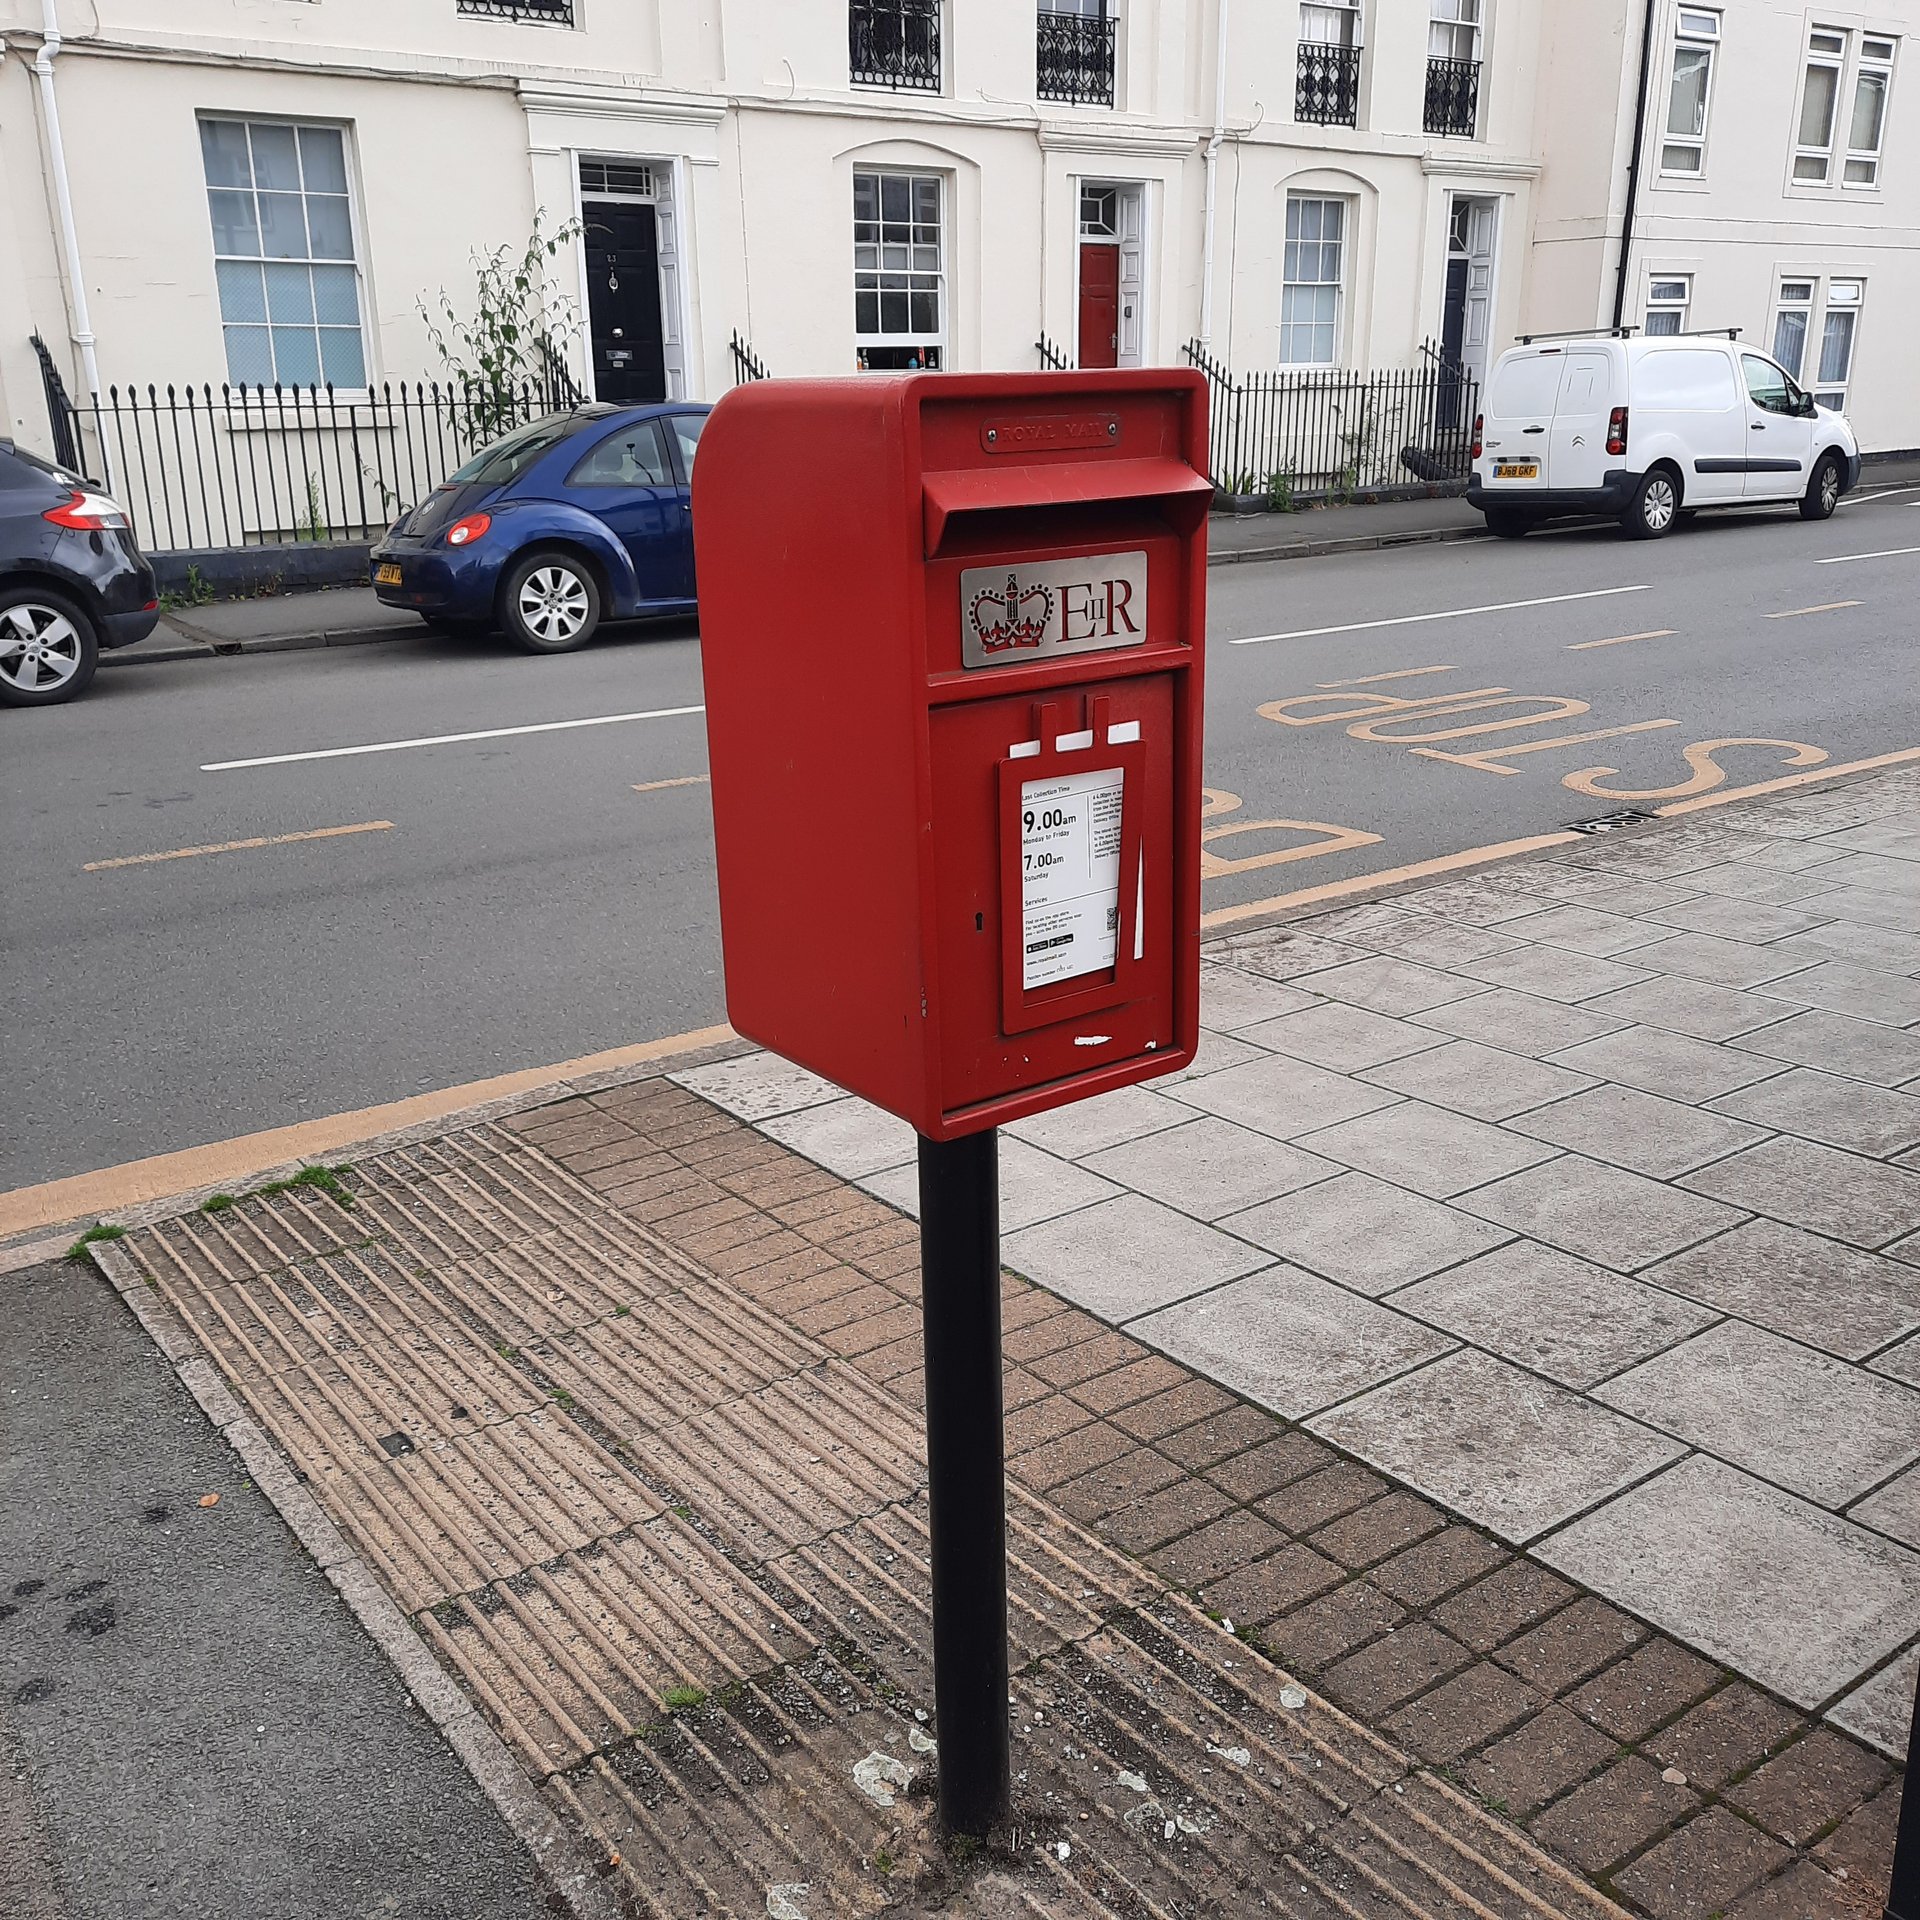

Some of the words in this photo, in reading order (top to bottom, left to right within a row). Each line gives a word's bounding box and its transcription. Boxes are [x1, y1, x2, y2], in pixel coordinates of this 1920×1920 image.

[1003, 425, 1055, 442] ROYAL
[1065, 422, 1104, 439] MAIL
[1518, 465, 1535, 475] GKF
[1034, 789, 1057, 799] Collection
[1023, 809, 1076, 833] 9.00am
[1023, 834, 1044, 845] Monday
[1053, 830, 1070, 839] Friday
[1024, 852, 1064, 871] 7.00am
[1024, 872, 1049, 882] Saturday
[1025, 896, 1048, 906] Services
